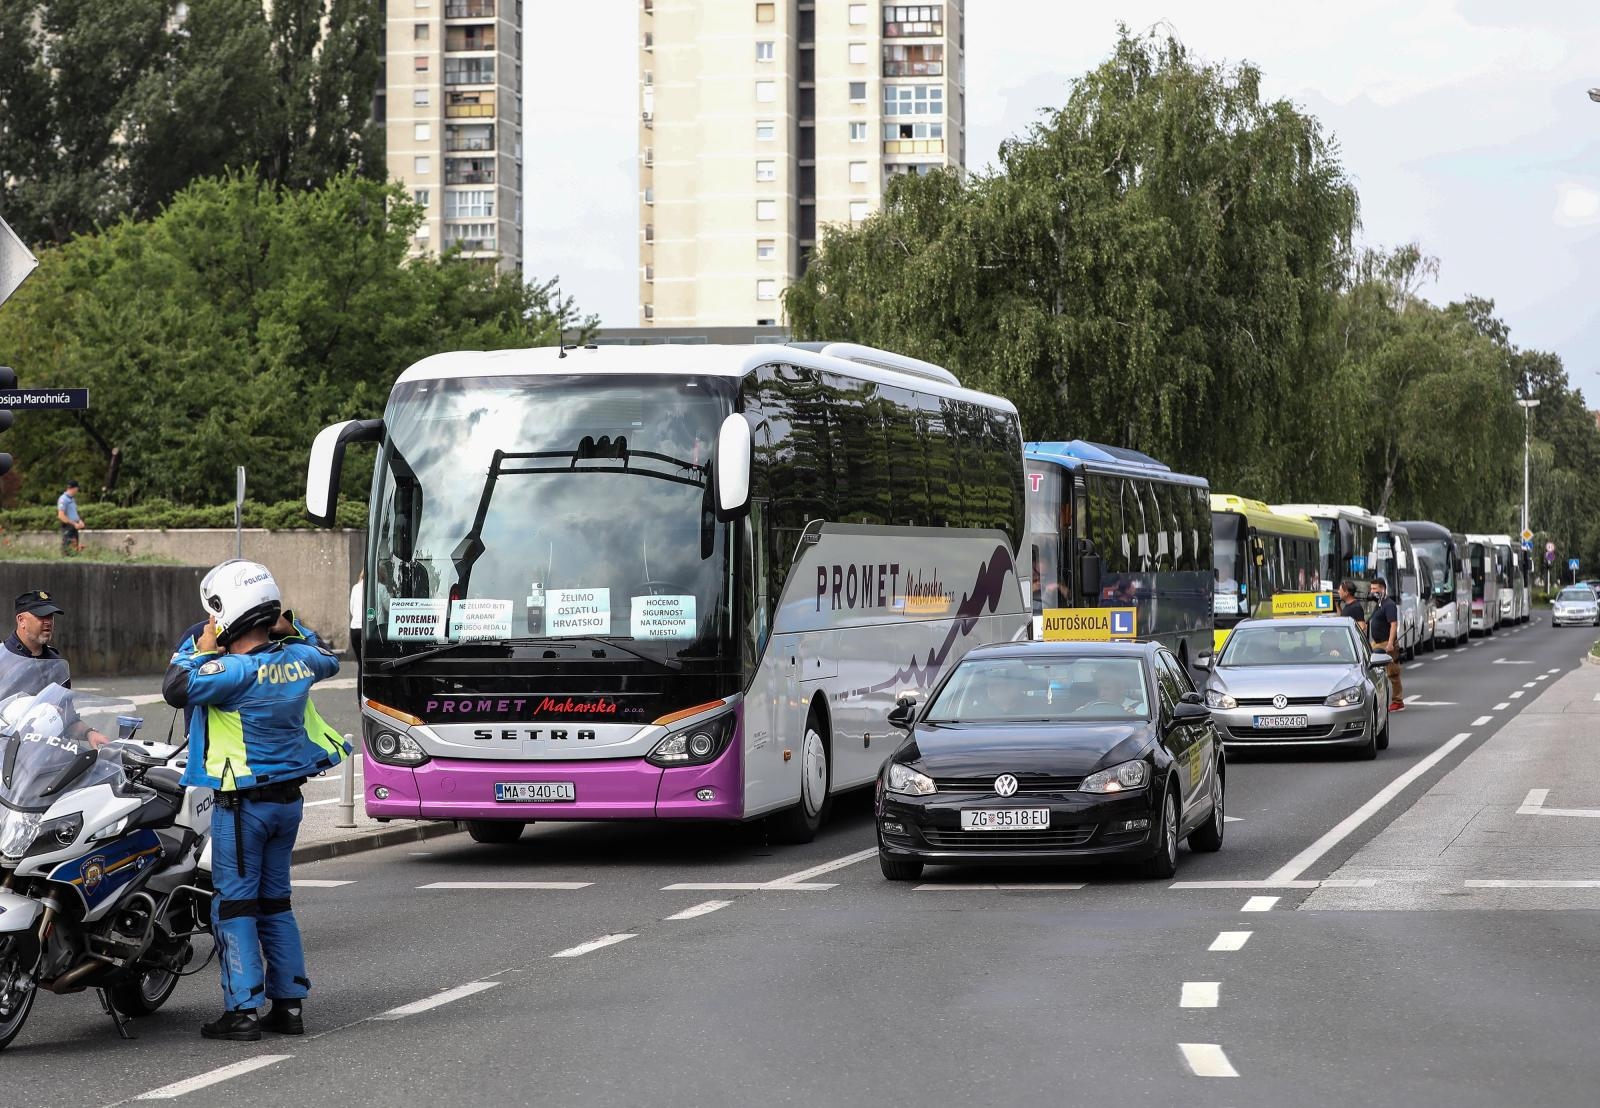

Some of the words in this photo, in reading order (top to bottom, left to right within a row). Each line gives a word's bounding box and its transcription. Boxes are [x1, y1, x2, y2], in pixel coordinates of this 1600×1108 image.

[23, 392, 70, 404] Marohnića
[816, 563, 900, 612] PROMET
[560, 593, 594, 602] ŽELIMO
[1318, 596, 1328, 607] L
[557, 607, 590, 615] OSTATI
[642, 609, 684, 617] SIGURNOST
[395, 614, 441, 624] POVREMENI
[552, 619, 604, 628] HRVATSKOJ
[1045, 614, 1109, 631] AUTOŠKOLA
[1115, 613, 1128, 632] L
[398, 627, 436, 636] PRIJEVOZ
[426, 699, 527, 713] PROMET
[533, 696, 617, 715] Makarska
[1259, 717, 1270, 726] ZG
[474, 729, 596, 740] SETRA
[504, 785, 519, 798] MA
[528, 785, 572, 798] 940-CL
[971, 811, 987, 826] ZG
